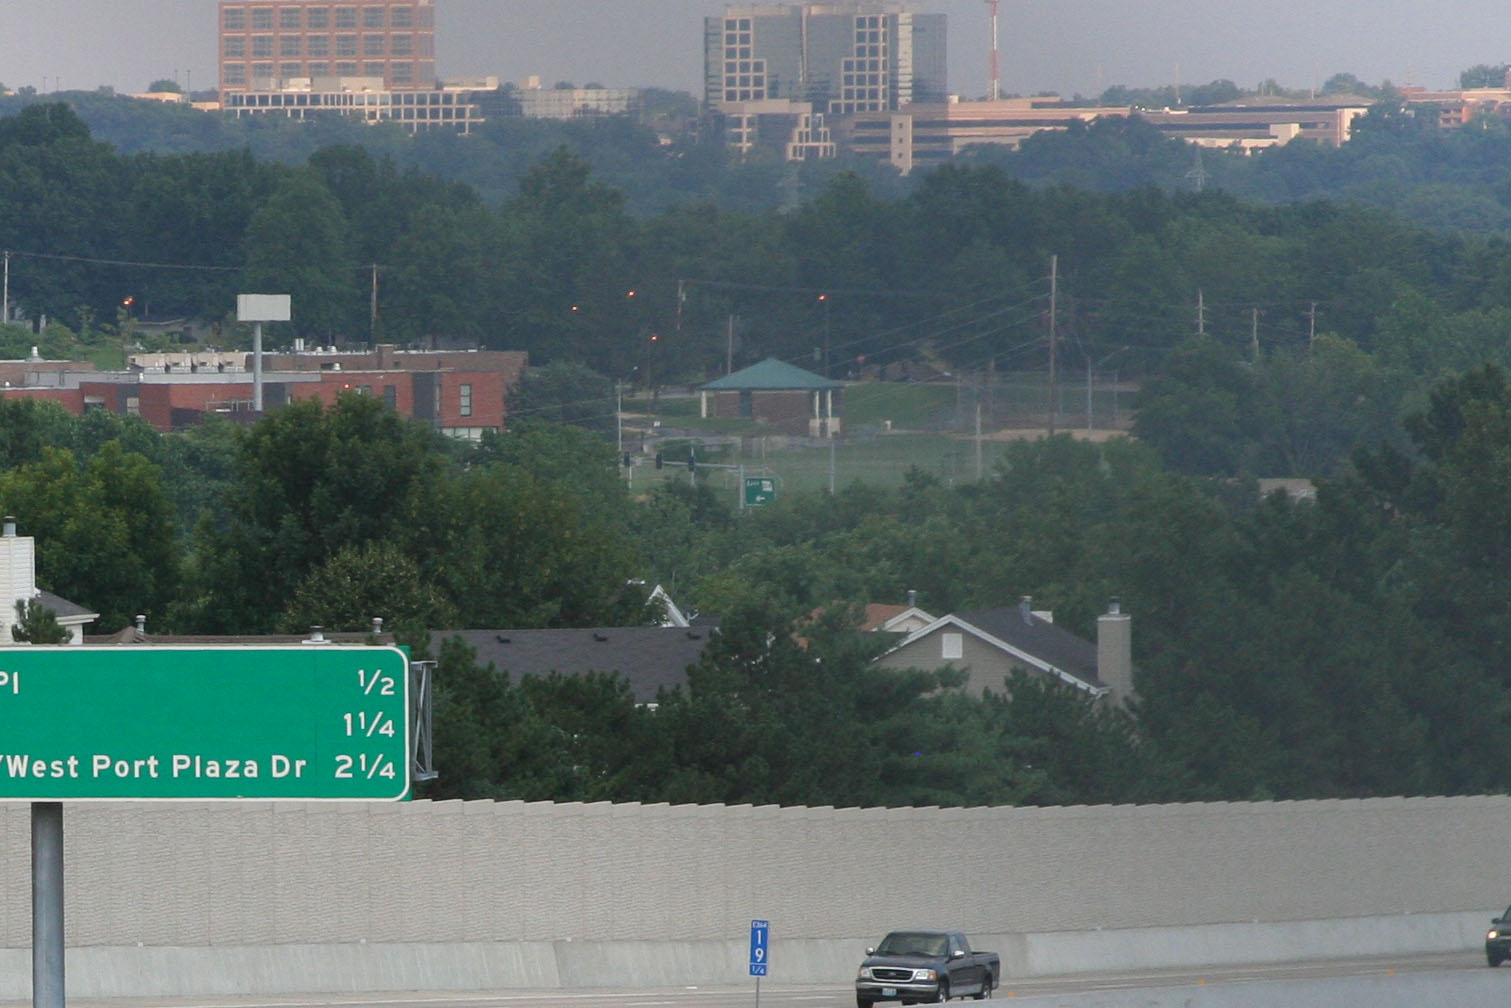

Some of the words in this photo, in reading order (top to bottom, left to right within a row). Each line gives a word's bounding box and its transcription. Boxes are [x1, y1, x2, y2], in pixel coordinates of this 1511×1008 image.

[92, 755, 159, 778] Port
[172, 755, 259, 778] Plaza
[271, 755, 307, 778] Dr
